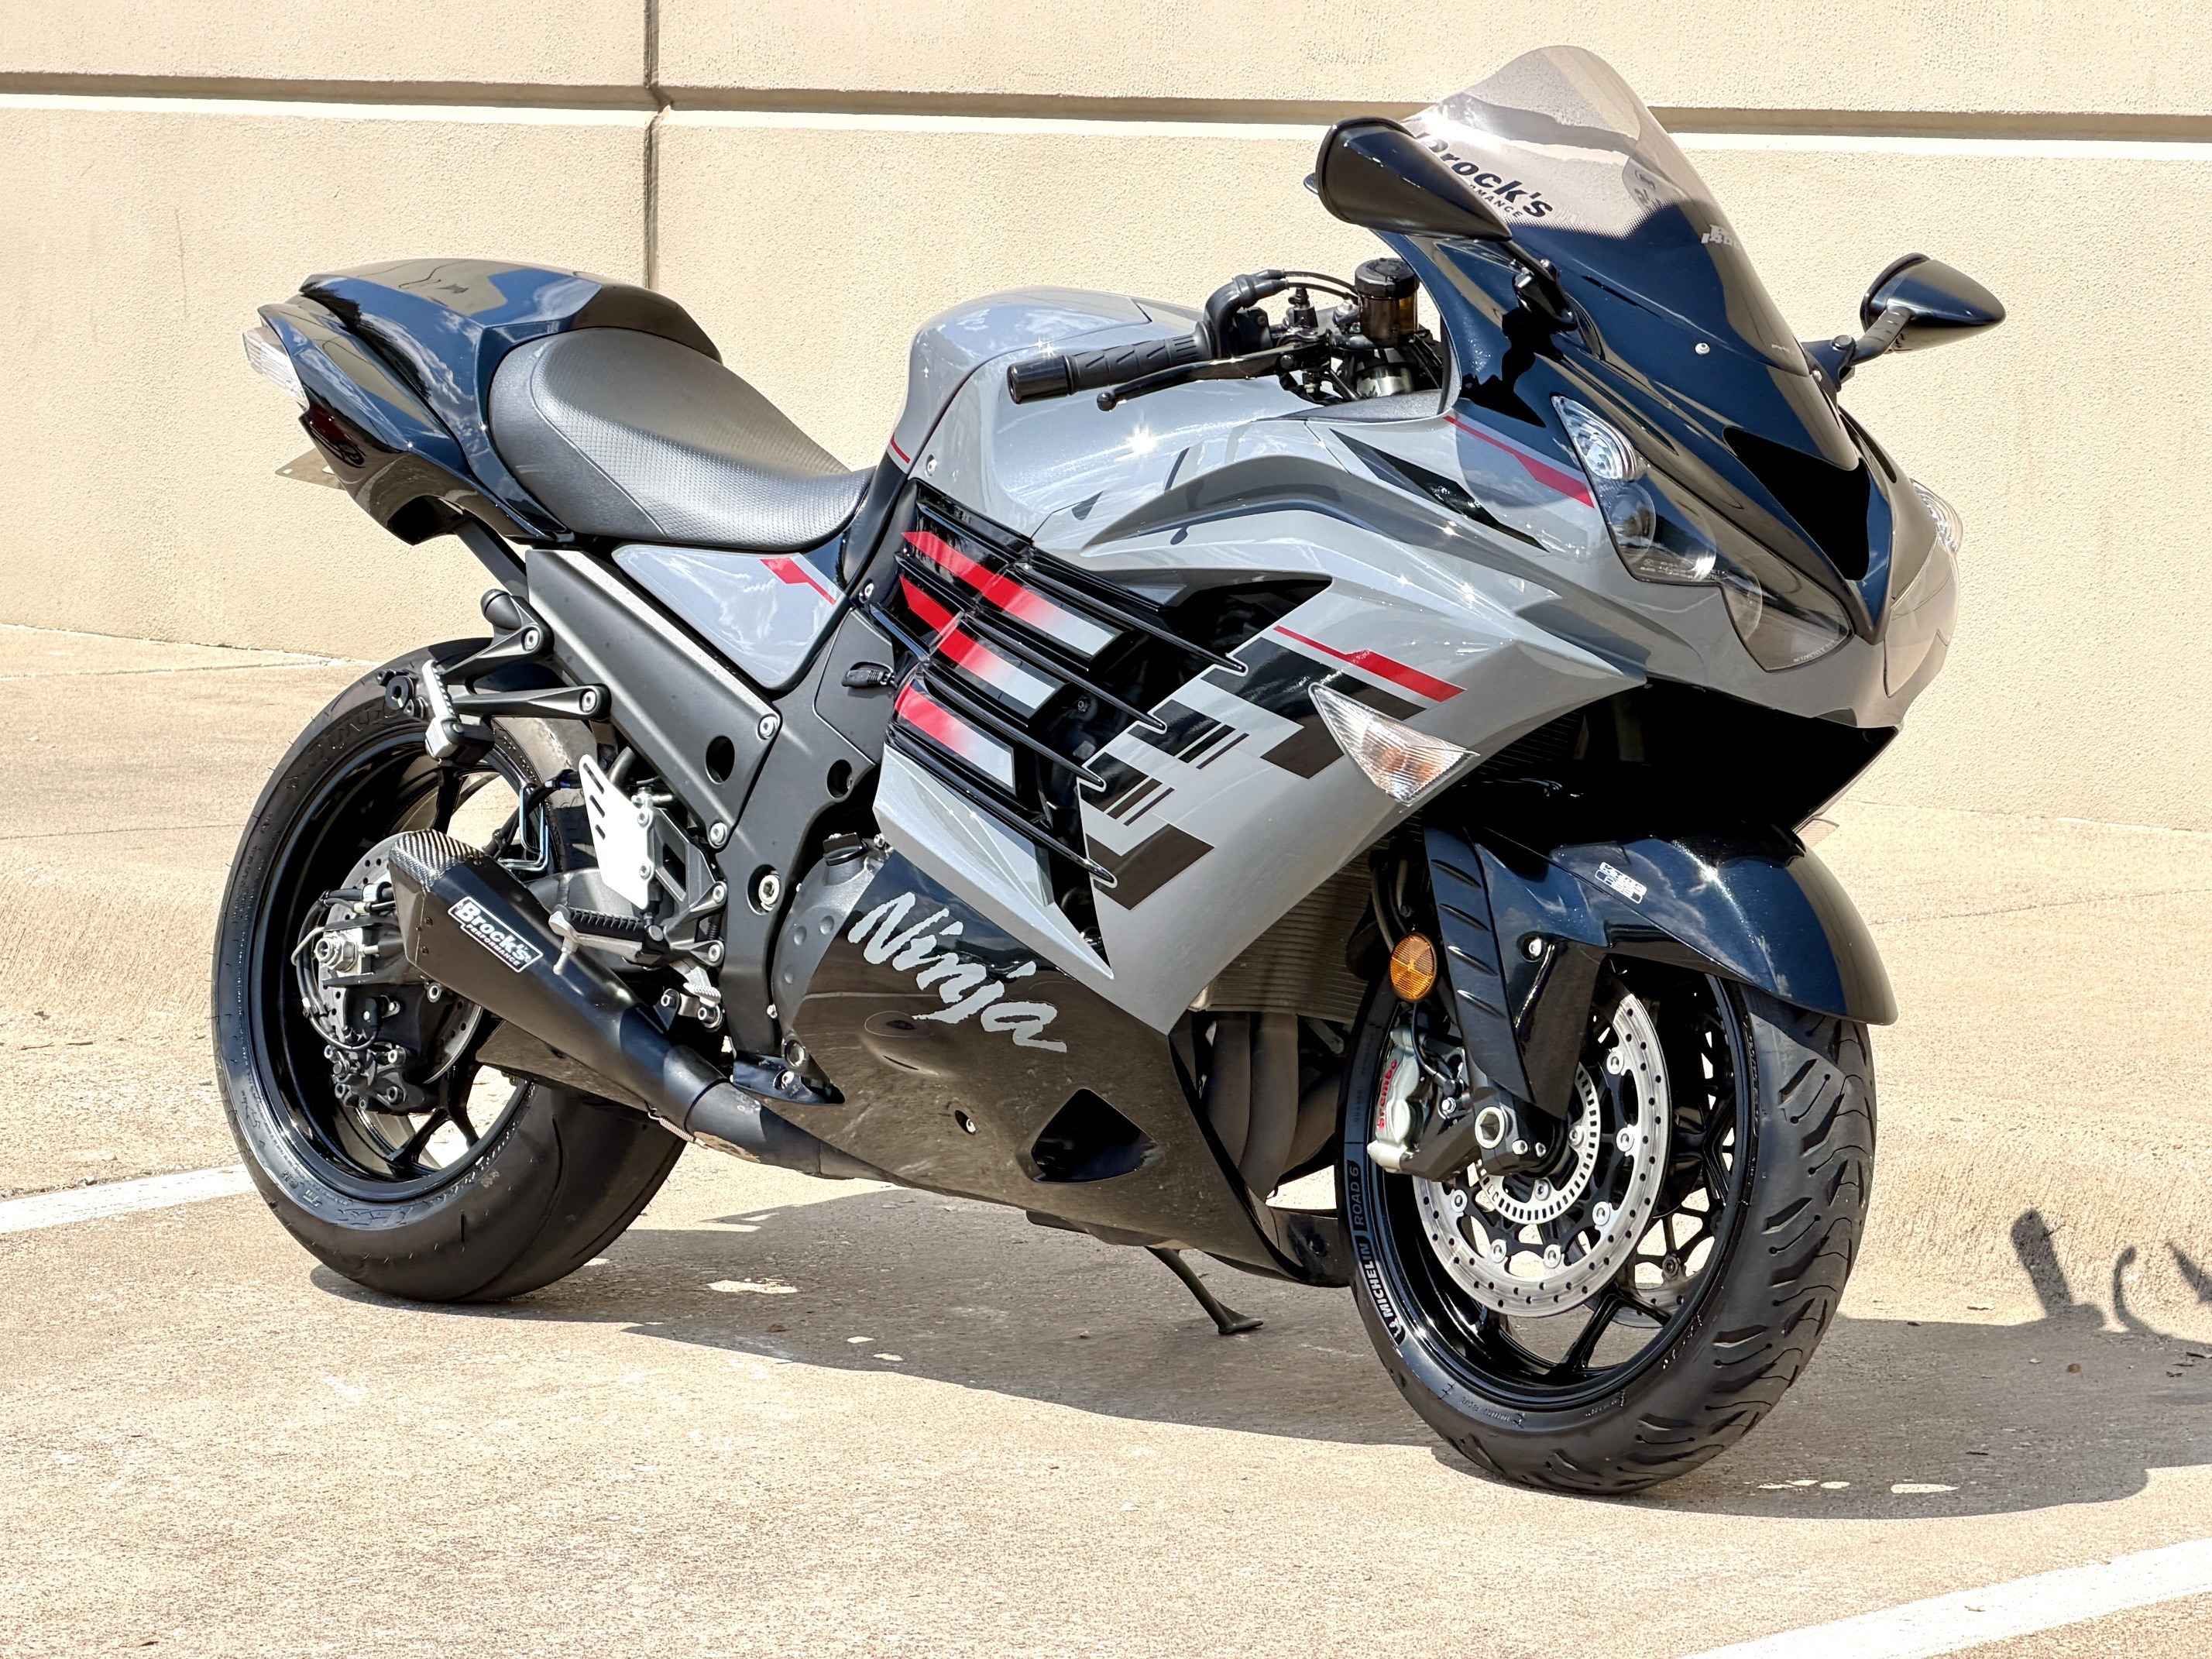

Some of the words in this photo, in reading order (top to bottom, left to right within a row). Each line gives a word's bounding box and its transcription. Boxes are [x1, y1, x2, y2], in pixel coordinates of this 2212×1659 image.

[455, 901, 531, 963] Brock's
[466, 924, 522, 967] PERFORMANCE
[847, 891, 1067, 1053] Ninja
[1377, 1059, 1398, 1130] brembo
[1350, 1166, 1359, 1176] 6
[1351, 1182, 1365, 1225] ROAD
[1358, 1243, 1393, 1318] MICHELIN
